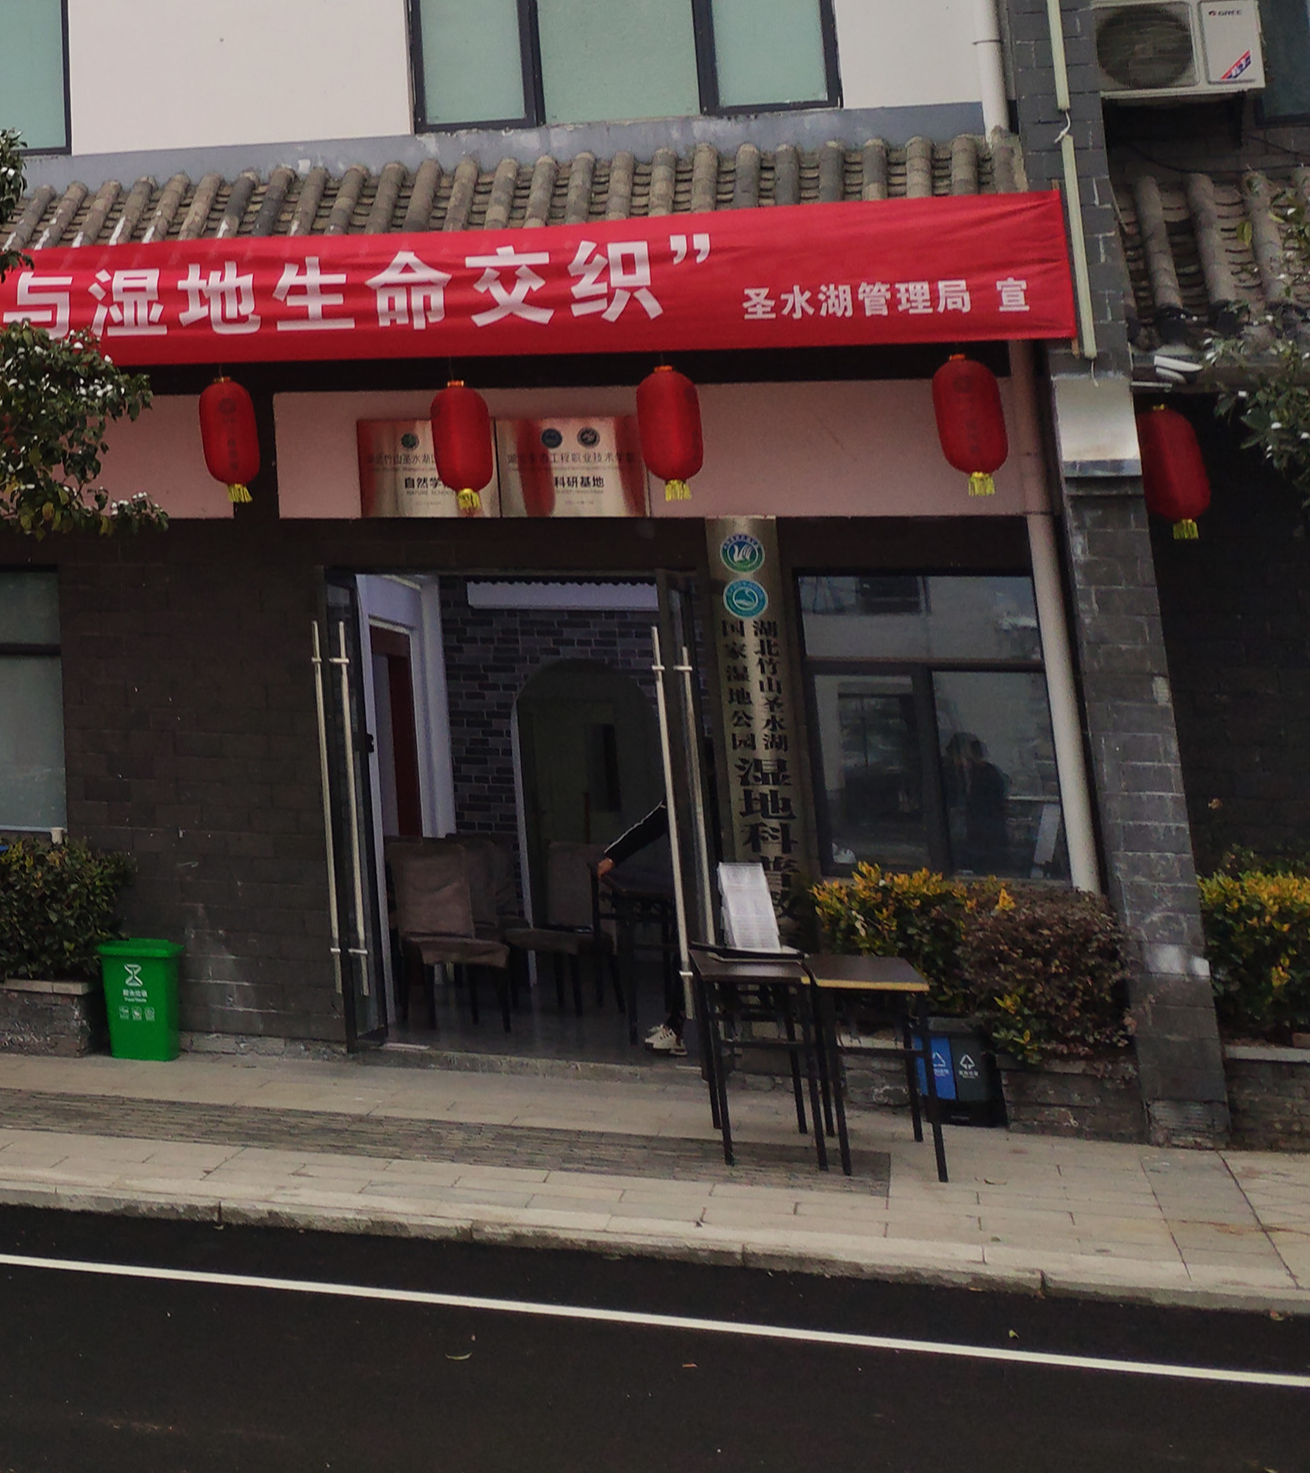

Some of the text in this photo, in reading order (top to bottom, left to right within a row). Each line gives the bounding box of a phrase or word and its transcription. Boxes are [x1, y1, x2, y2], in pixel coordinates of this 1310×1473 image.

[742, 277, 1030, 319] 圣水湖管理局 宣
